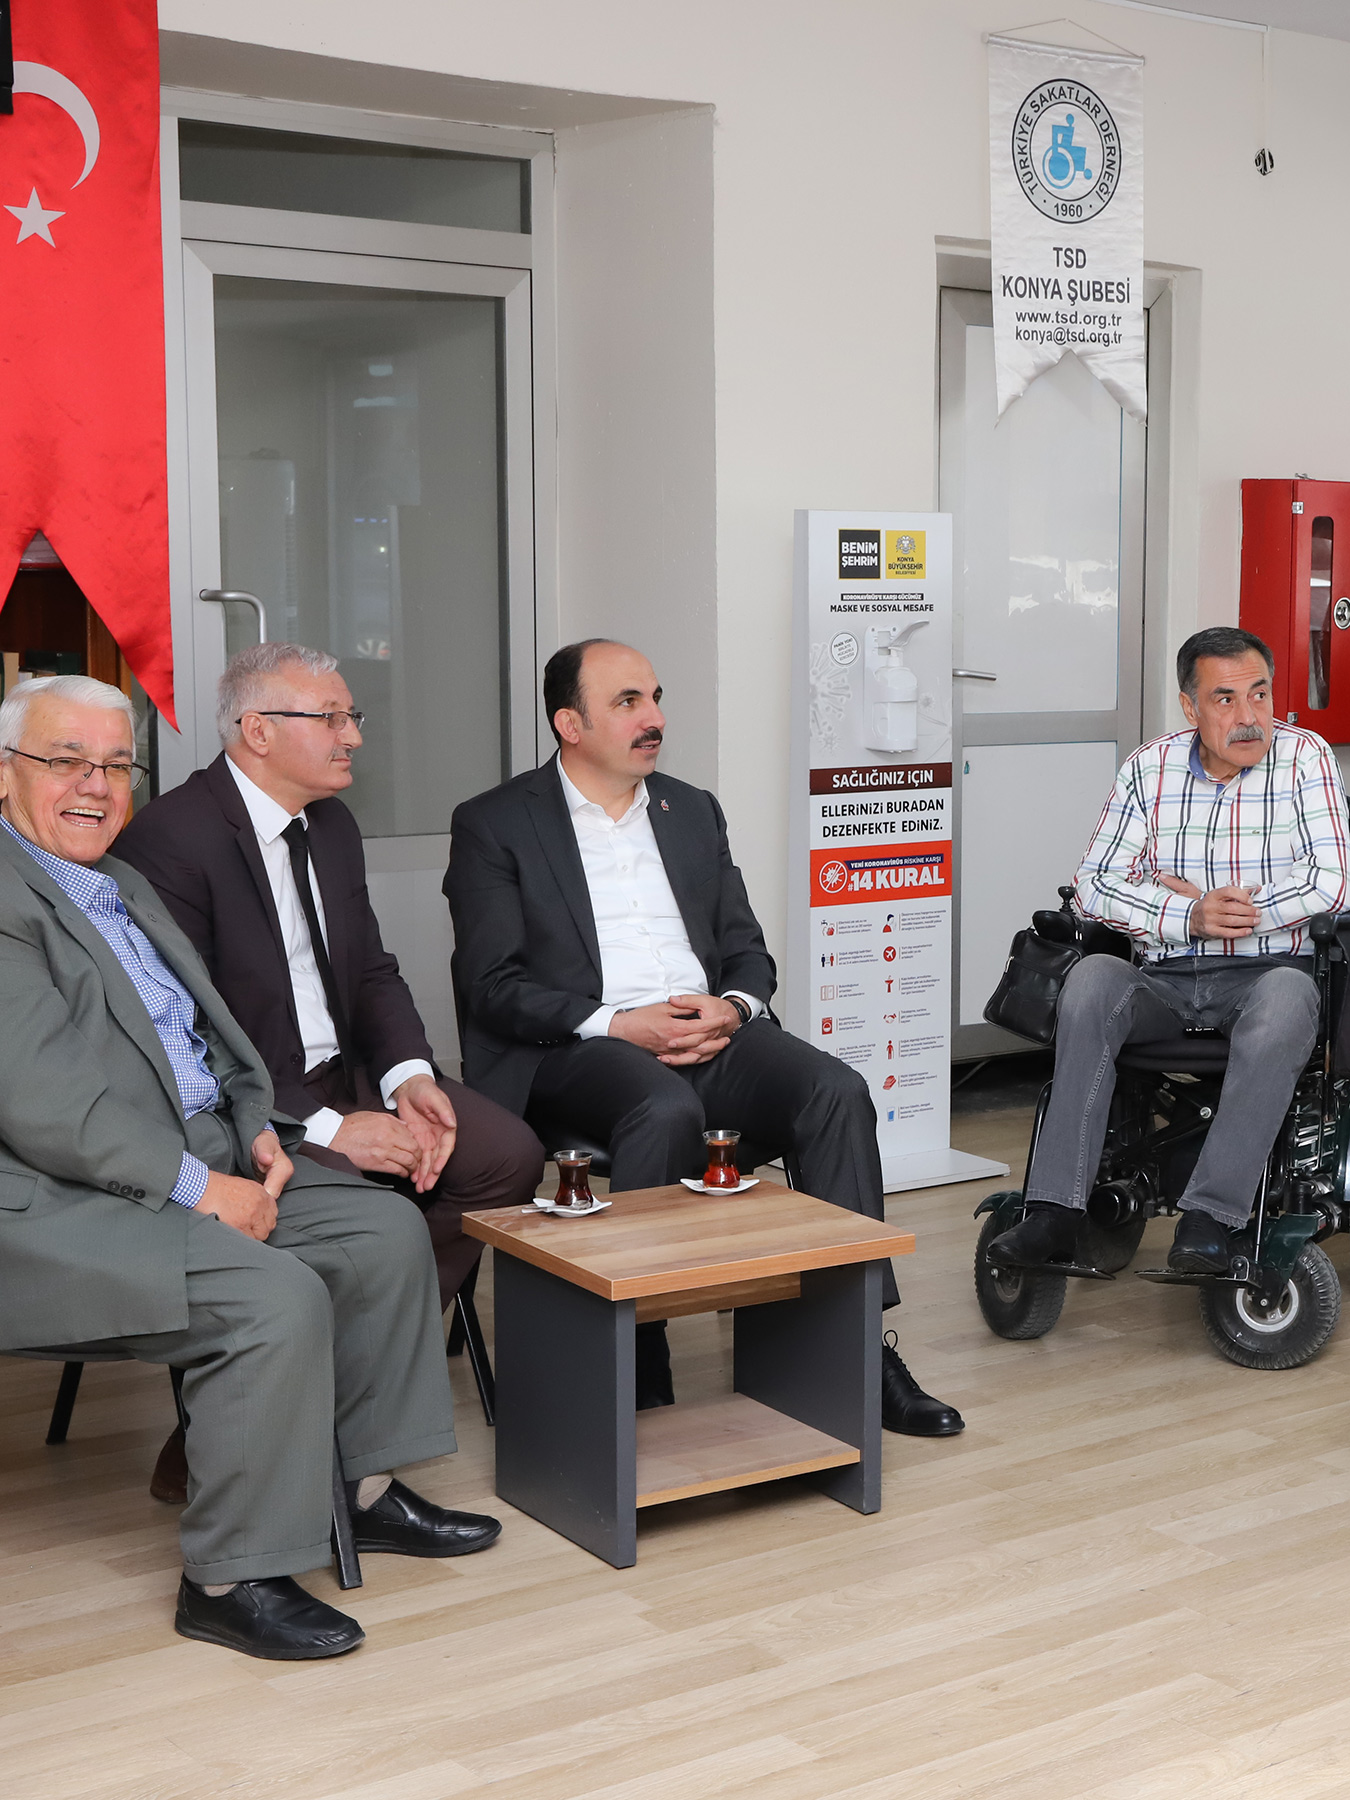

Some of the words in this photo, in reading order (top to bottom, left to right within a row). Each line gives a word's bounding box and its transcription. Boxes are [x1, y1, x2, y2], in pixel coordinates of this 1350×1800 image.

[1016, 113, 1038, 195] TÜRKİYE
[1030, 86, 1101, 119] SAKATLAR
[1096, 120, 1117, 202] DERNEĞİ
[1054, 203, 1083, 218] 1960
[1053, 247, 1087, 269] TSD
[1002, 275, 1063, 300] KONYA
[1067, 277, 1130, 306] ŞUBESİ
[1015, 311, 1122, 329] www.tsd.org.tr
[1015, 326, 1123, 347] konya@tsd.org.tr
[830, 604, 858, 612] MASKE
[860, 604, 870, 612] VE
[871, 604, 902, 612] SOSYAL
[832, 769, 905, 789] SAĞLIĞINIZ
[821, 801, 884, 818] ELLERİNİZİ
[886, 798, 944, 814] BURADAN
[822, 821, 896, 838] DEZENFEKTE
[851, 861, 864, 869] YENİ
[865, 857, 903, 868] KORONAVİRÜS
[904, 856, 924, 865] RİSKİNE
[925, 855, 941, 864] KARŞI
[847, 870, 873, 892] #14
[876, 866, 945, 890] KURAL
